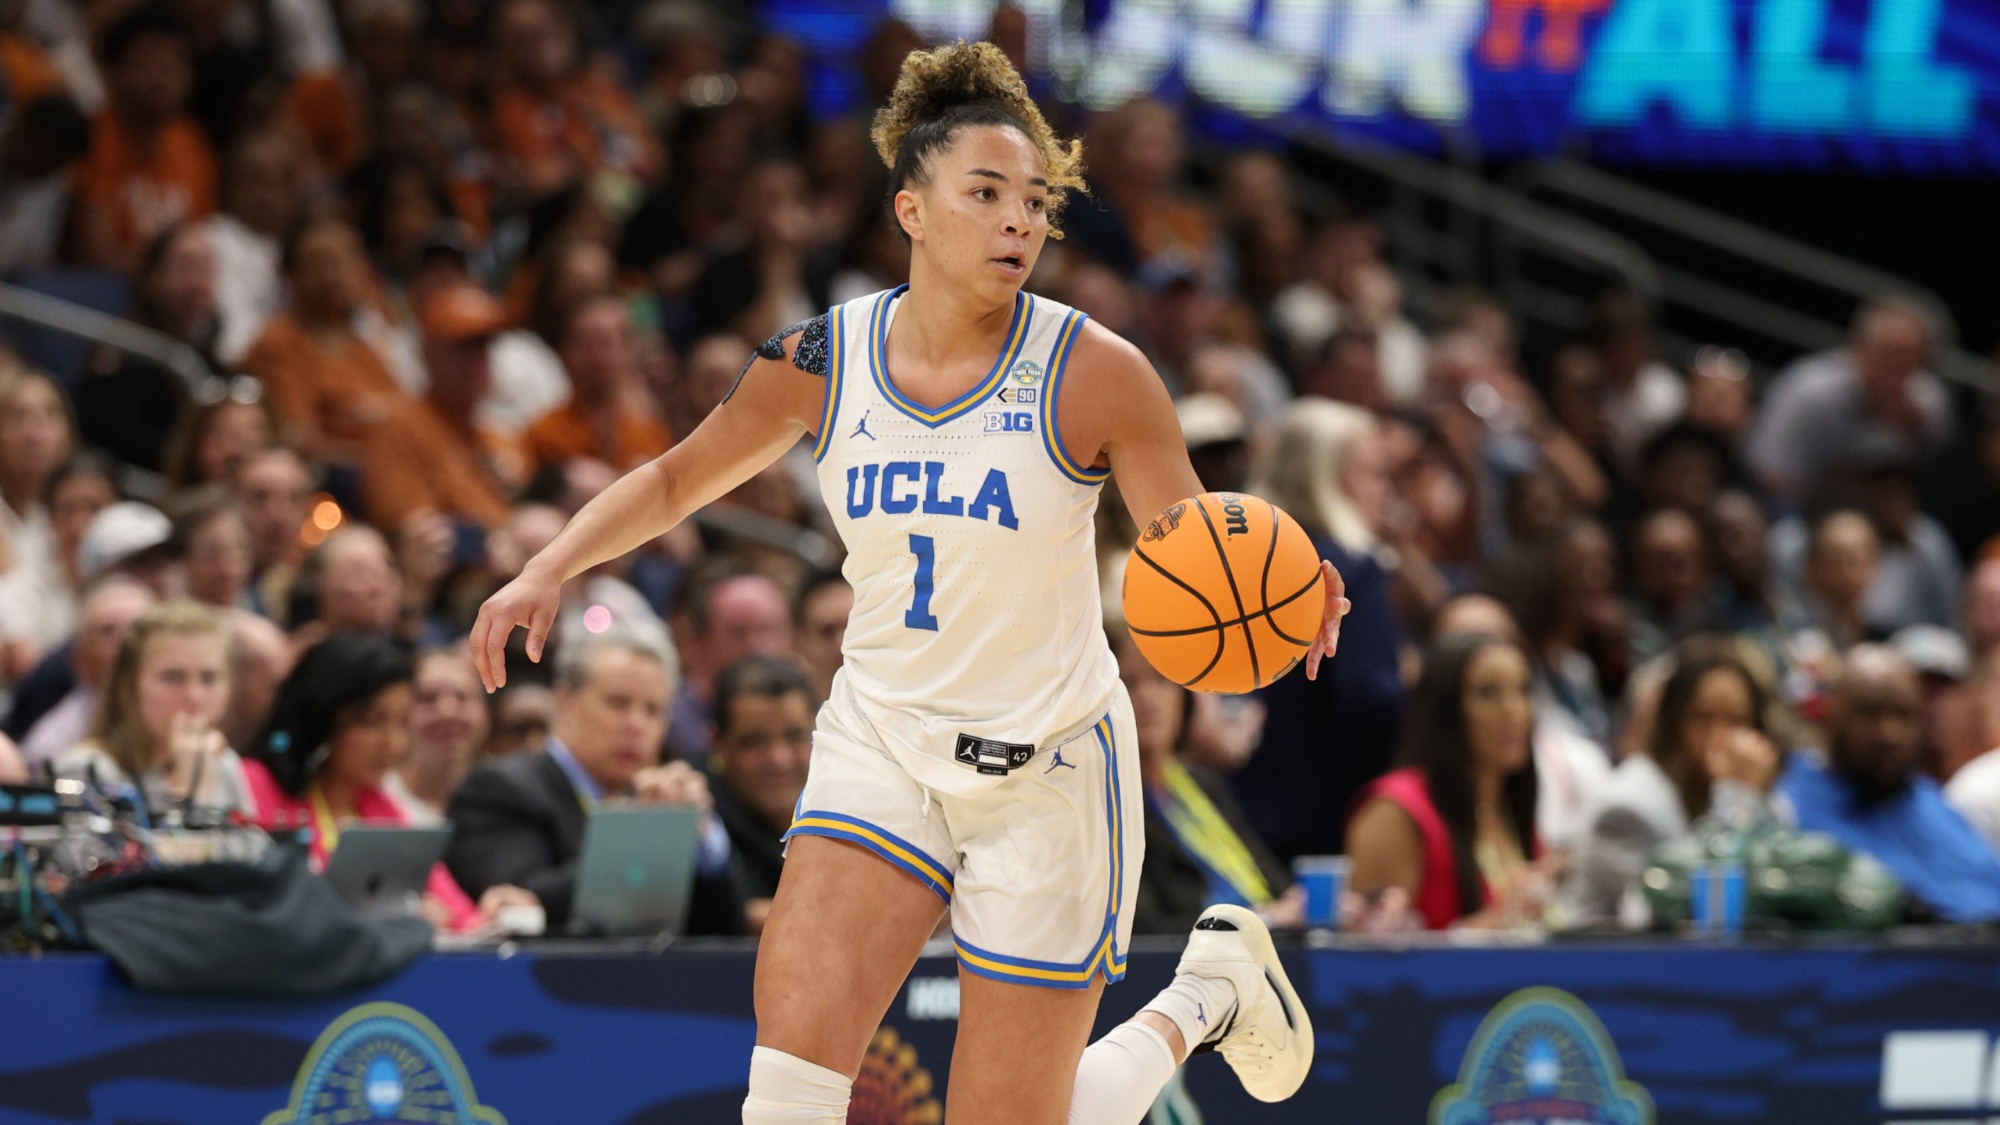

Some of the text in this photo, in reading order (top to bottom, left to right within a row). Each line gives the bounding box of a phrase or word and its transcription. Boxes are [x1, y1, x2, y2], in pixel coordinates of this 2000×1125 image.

[1576, 0, 1975, 138] ALL
[1019, 389, 1035, 402] 90
[847, 461, 1019, 531] UCLA
[905, 533, 938, 631] 1
[1013, 751, 1028, 762] 42
